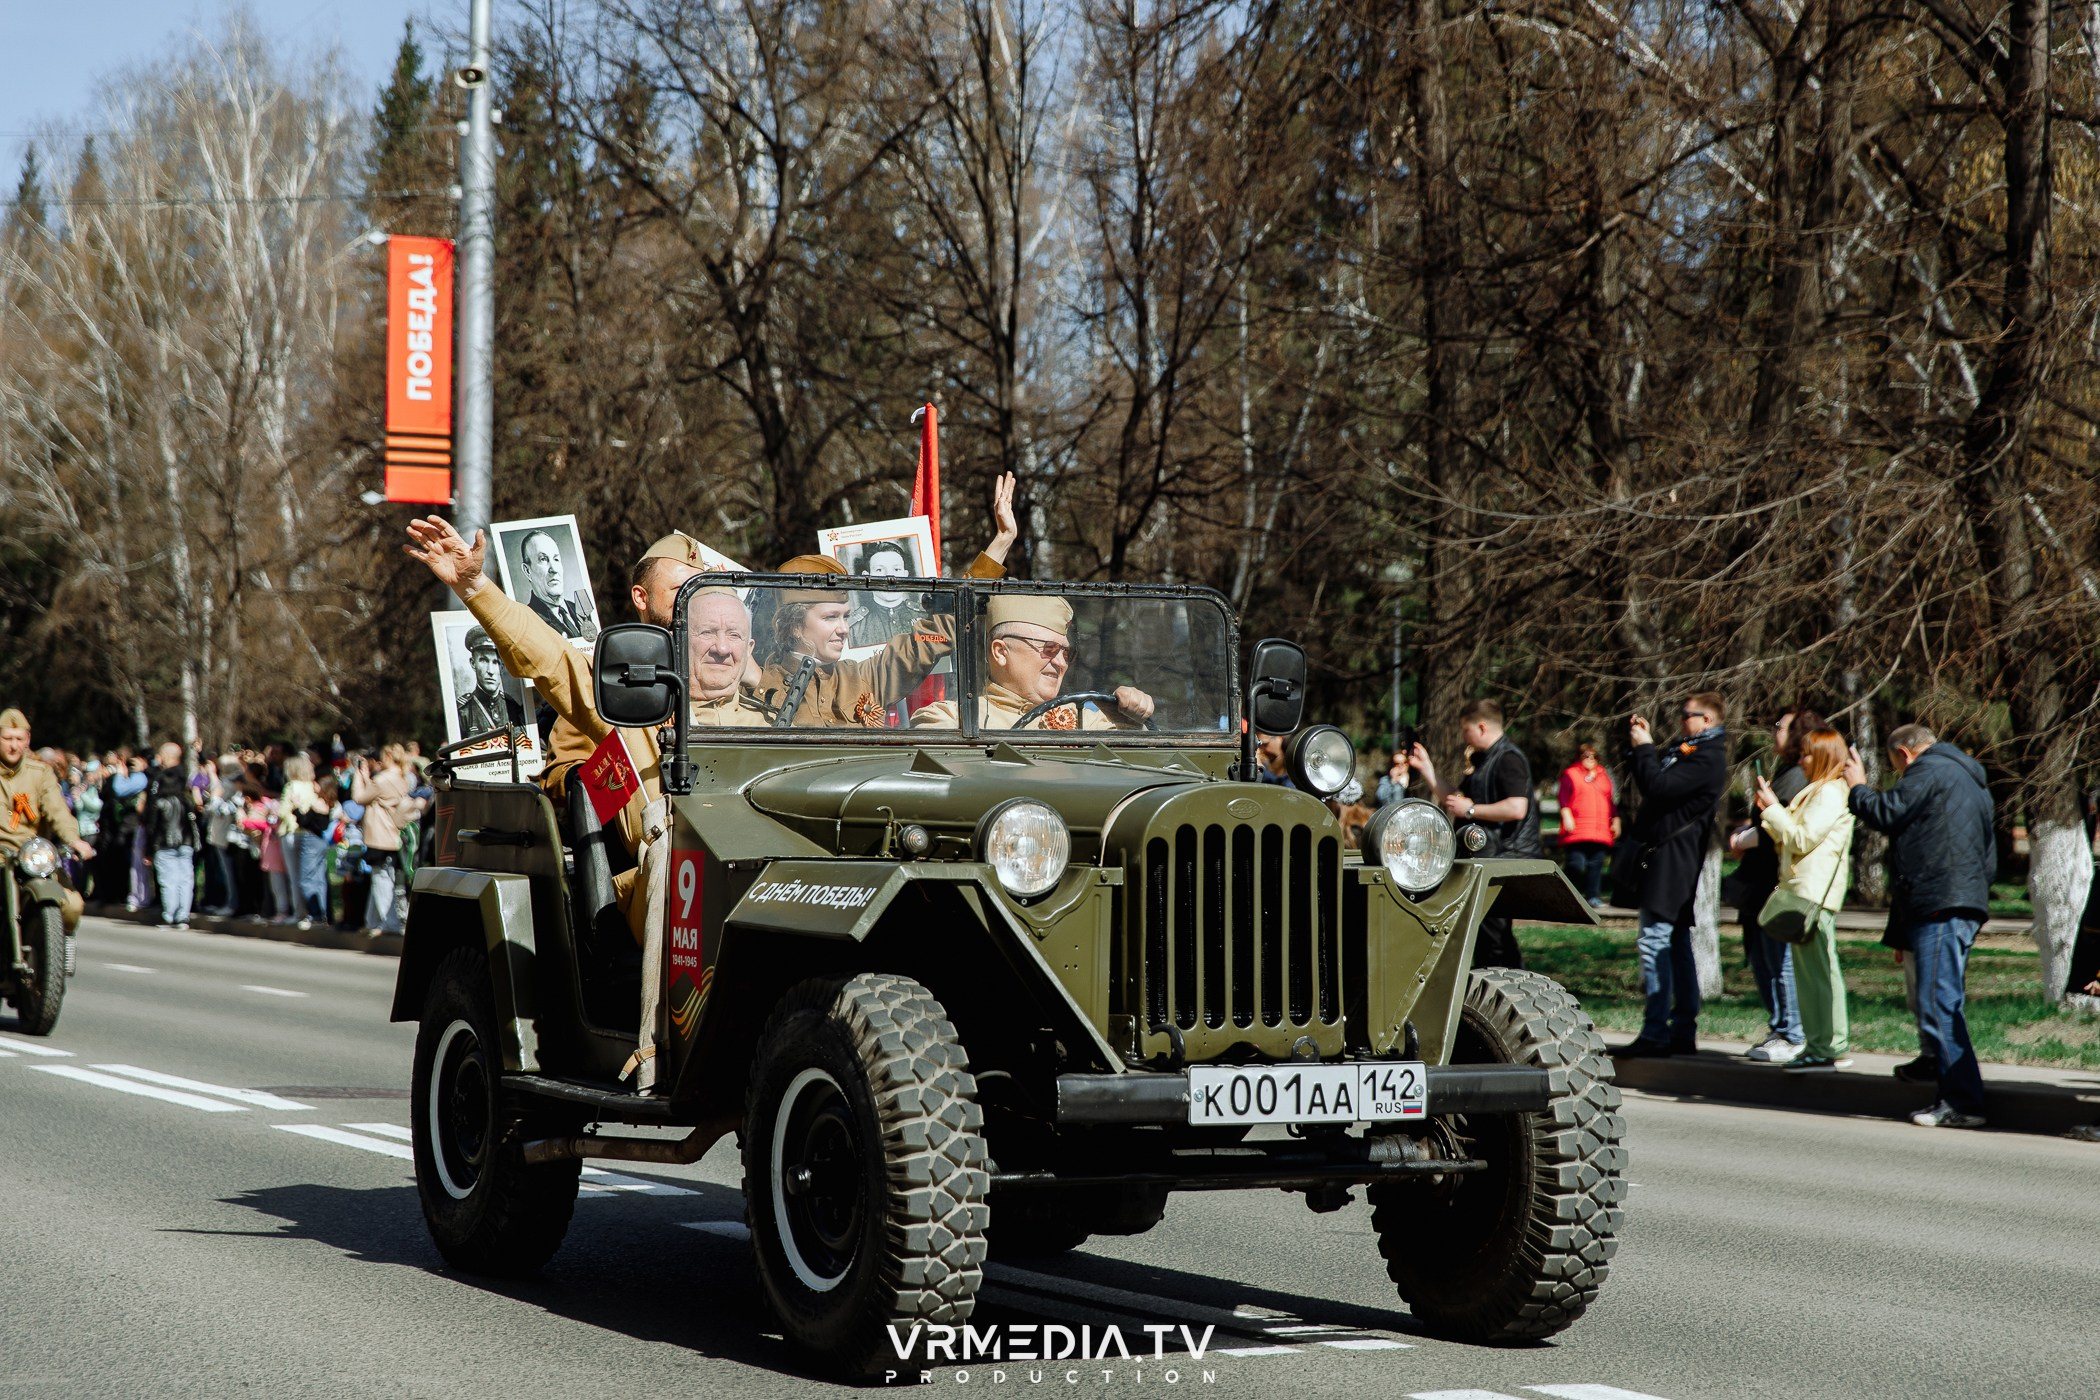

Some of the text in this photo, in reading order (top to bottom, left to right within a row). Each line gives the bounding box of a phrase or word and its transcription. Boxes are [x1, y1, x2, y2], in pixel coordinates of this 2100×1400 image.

[406, 253, 437, 401] ПОБЕДА!
[678, 859, 696, 919] 9
[748, 879, 877, 910] С ДНЁМ ПОБЕДЫ!
[672, 926, 698, 950] МАЯ
[672, 954, 697, 968] 1941-1945
[1204, 1068, 1415, 1117] К001АА 142
[1375, 1102, 1402, 1114] RUS
